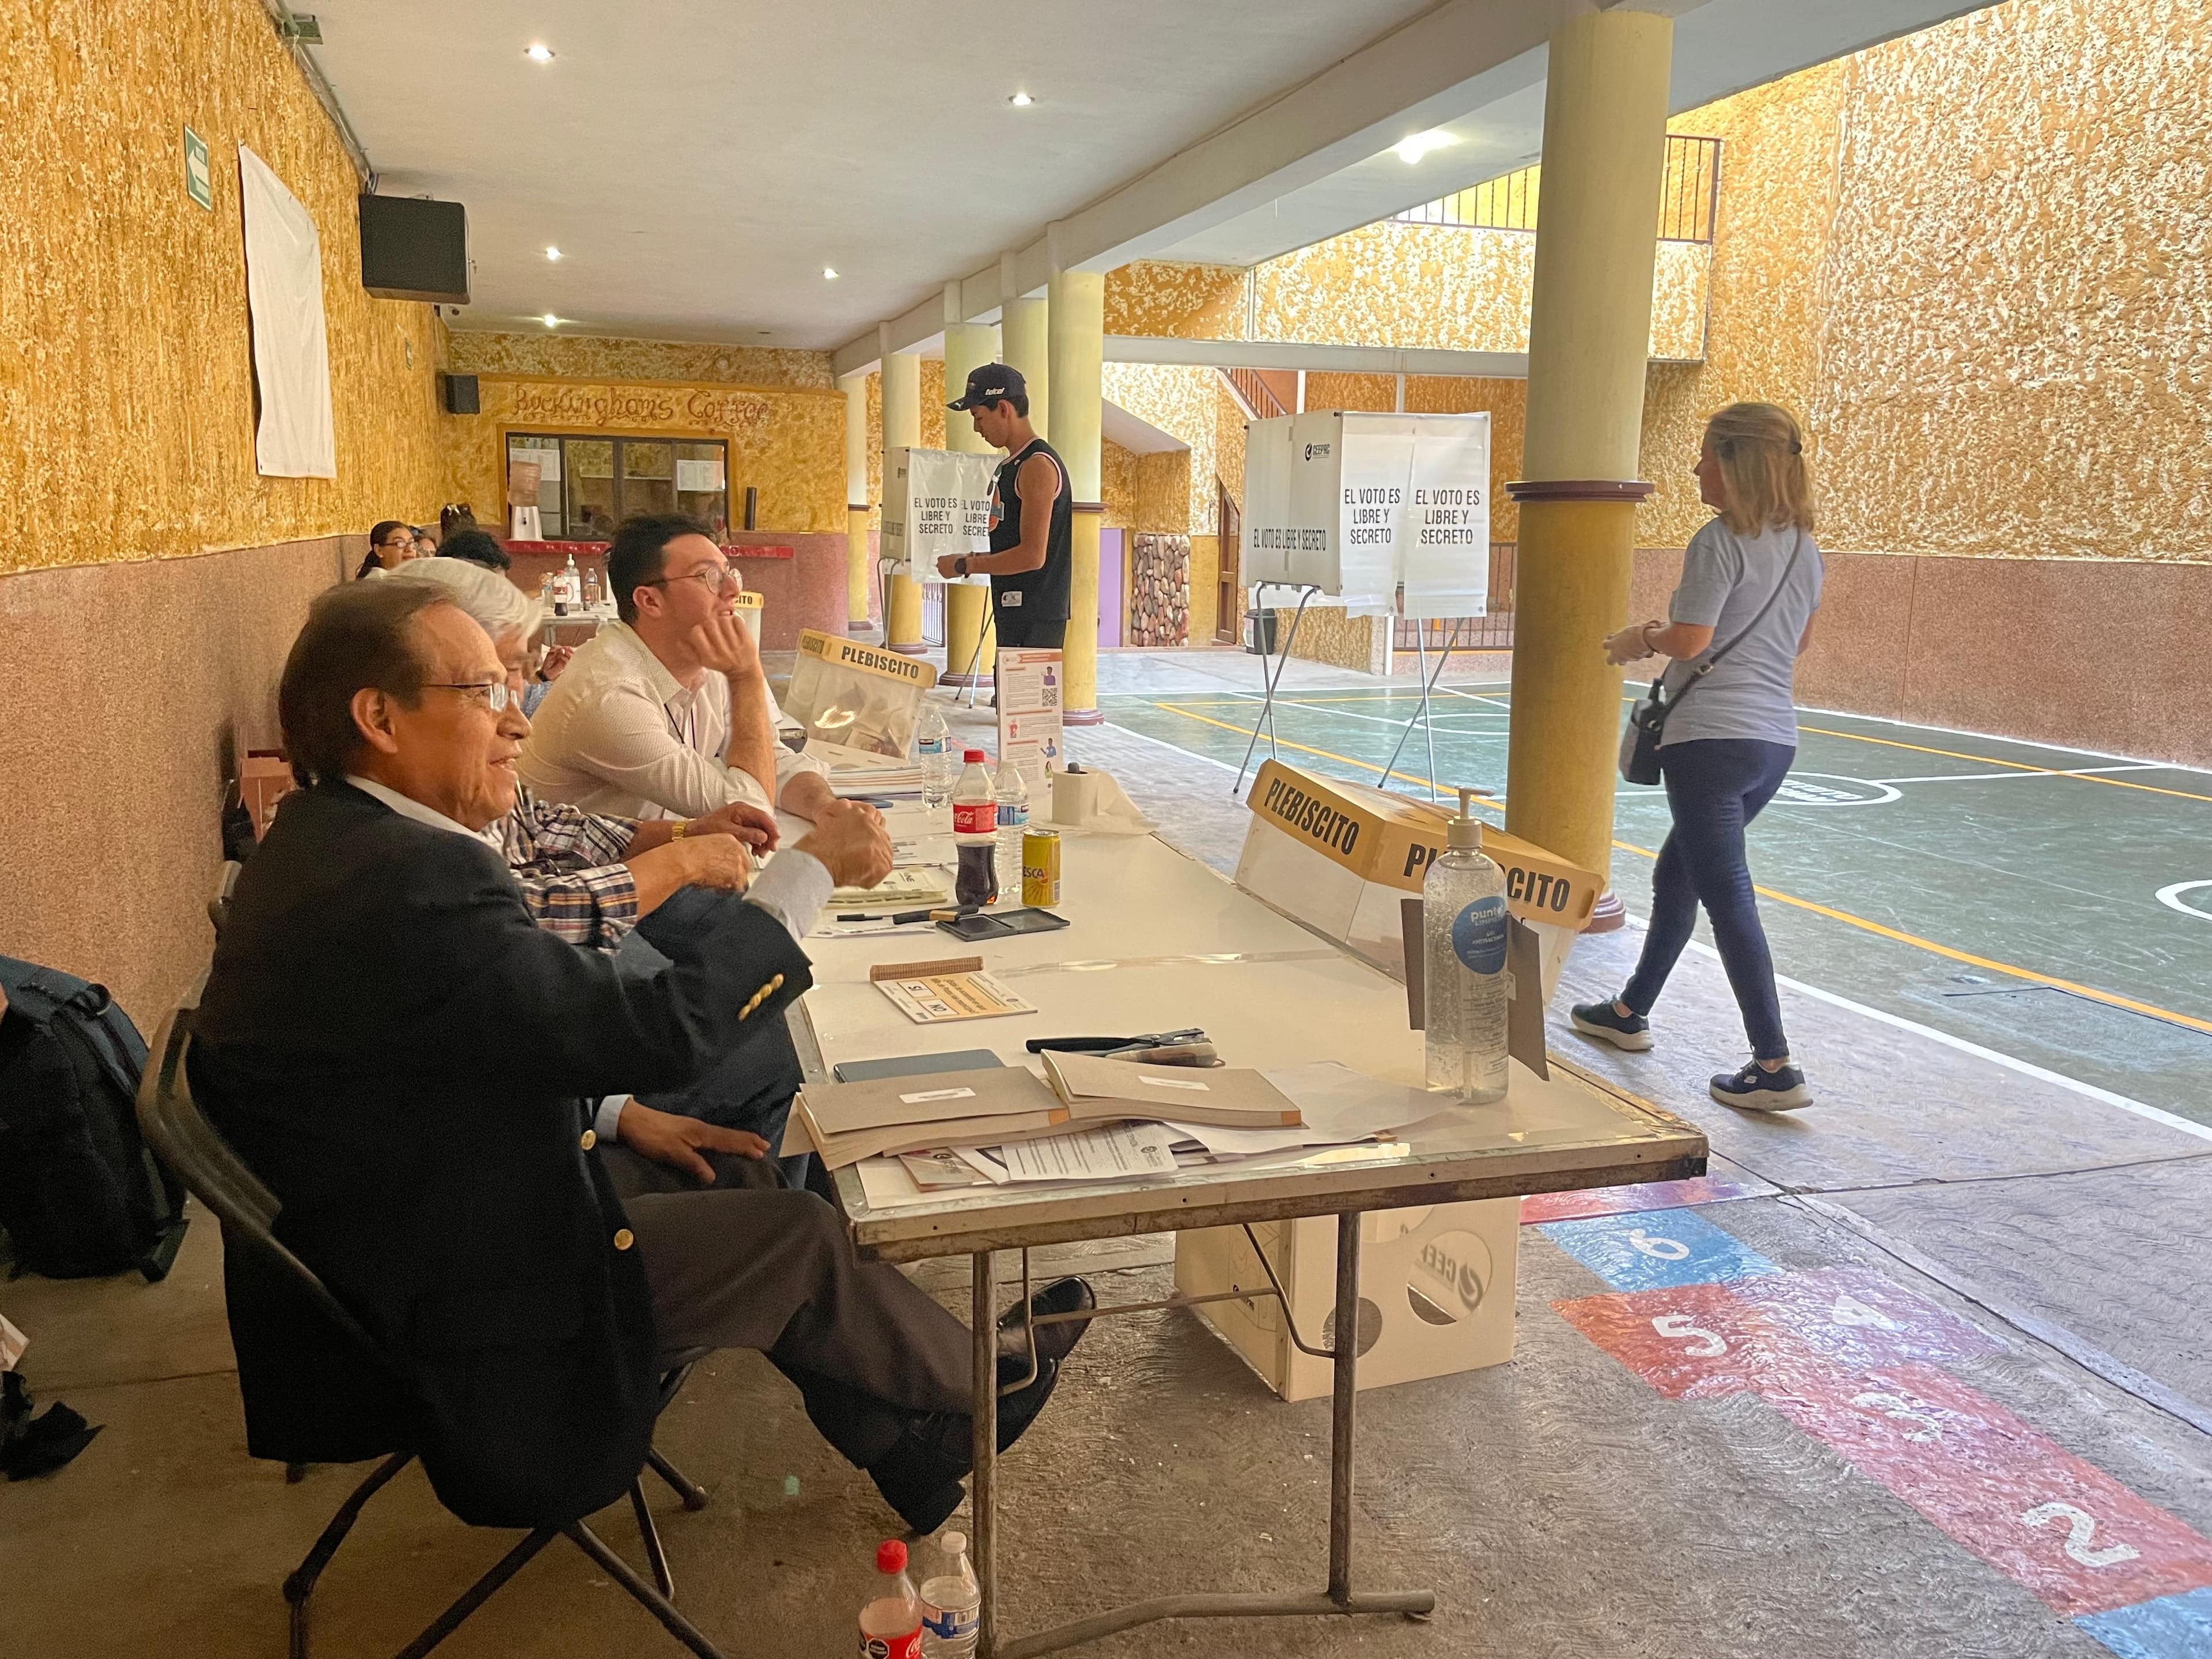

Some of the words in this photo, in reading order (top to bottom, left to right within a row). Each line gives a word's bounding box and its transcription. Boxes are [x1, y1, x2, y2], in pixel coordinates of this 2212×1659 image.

[687, 389, 768, 426] Coffee
[914, 497, 923, 508] EL
[925, 497, 946, 508] VOTO
[948, 498, 957, 508] ES
[1344, 488, 1356, 504] EL
[1359, 488, 1385, 504] VOTO
[1389, 488, 1400, 503] ES
[1415, 490, 1428, 505] EL
[1433, 490, 1462, 505] VOTO
[1467, 490, 1480, 505] ES
[970, 500, 990, 511] VOTO
[921, 511, 943, 521] LIBRE
[945, 511, 950, 521] Y
[965, 512, 987, 524] LIBRE
[1353, 509, 1381, 524] LIBRE
[1384, 508, 1390, 524] Y
[1425, 510, 1458, 525] LIBRE
[1461, 510, 1469, 524] Y
[919, 524, 953, 534] SECRETO
[1350, 528, 1391, 544] SECRETO
[1421, 529, 1473, 544] SECRETO
[1253, 528, 1260, 548] EL
[1262, 528, 1274, 548] VOTO
[1275, 529, 1282, 549] ES
[1282, 529, 1296, 550] LIBRE
[1298, 529, 1301, 550] Y
[1302, 529, 1326, 551] SECRETO
[841, 646, 919, 679] PLEBISCITO
[1264, 778, 1359, 855] PLEBISCITO
[1629, 1228, 1690, 1260] 6
[1651, 1315, 1728, 1357] 5
[1849, 1391, 1943, 1442] 3
[2022, 1502, 2142, 1568] 2
